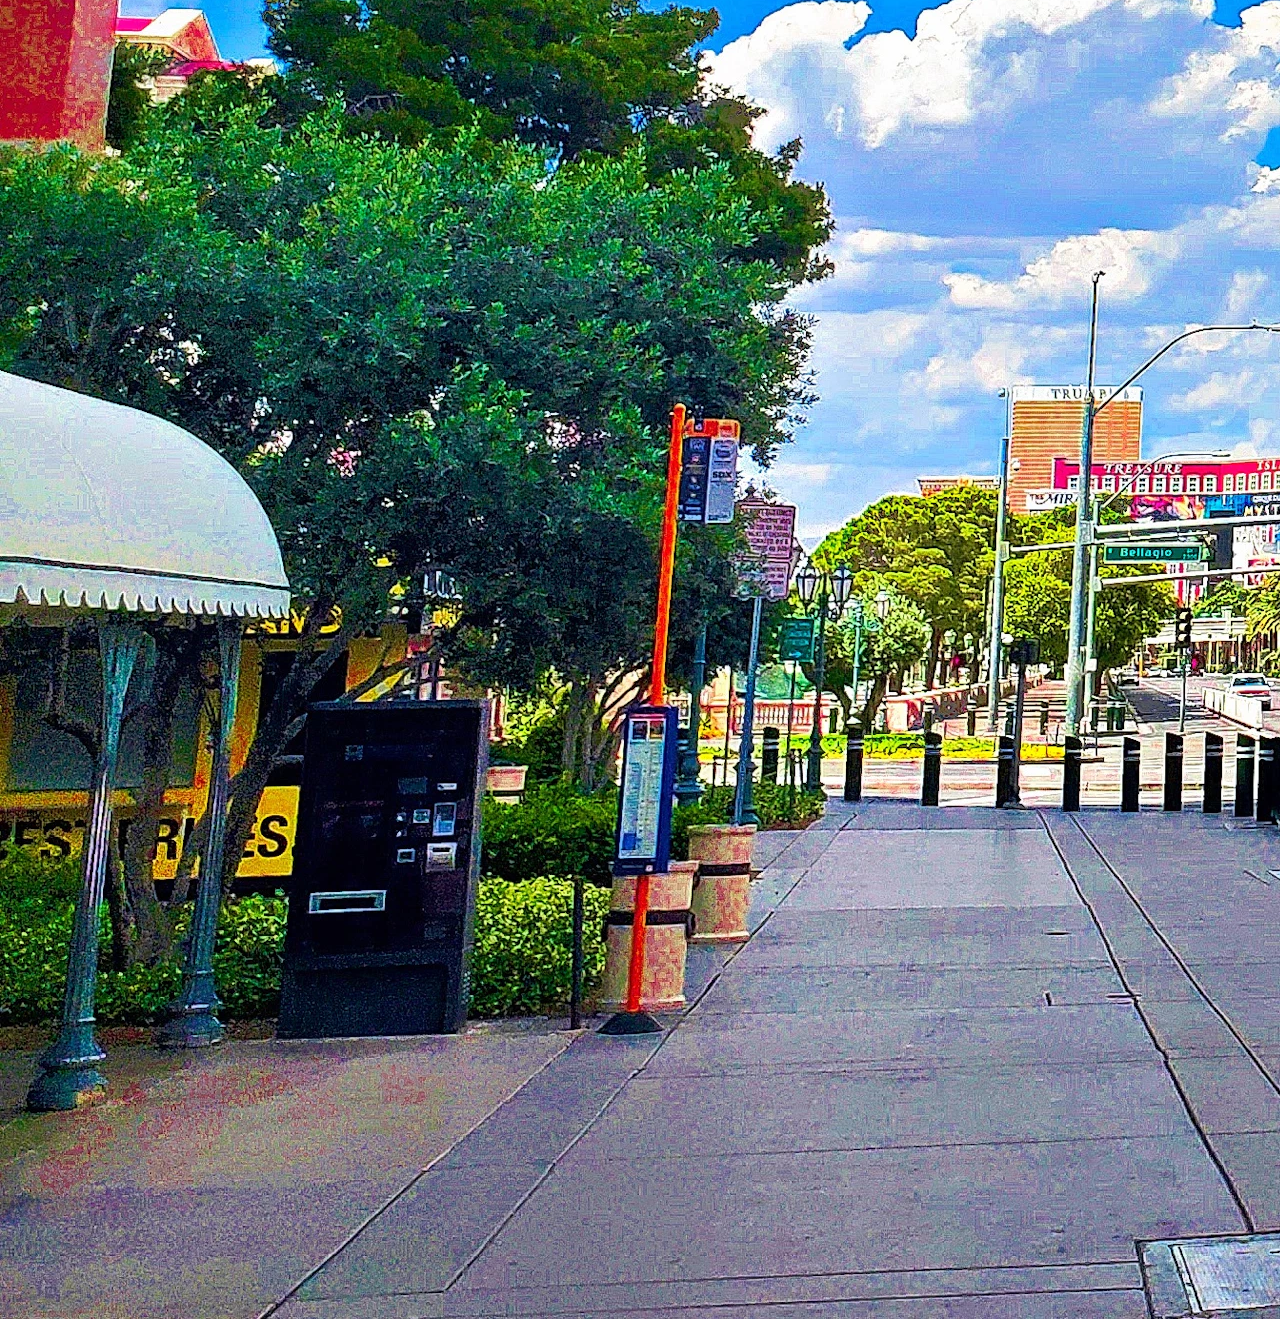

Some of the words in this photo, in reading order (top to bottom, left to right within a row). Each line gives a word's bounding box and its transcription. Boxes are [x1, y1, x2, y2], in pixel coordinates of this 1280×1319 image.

[1051, 388, 1107, 400] TRUP
[1103, 464, 1182, 475] TREASURE
[1120, 548, 1172, 559] Bellagio
